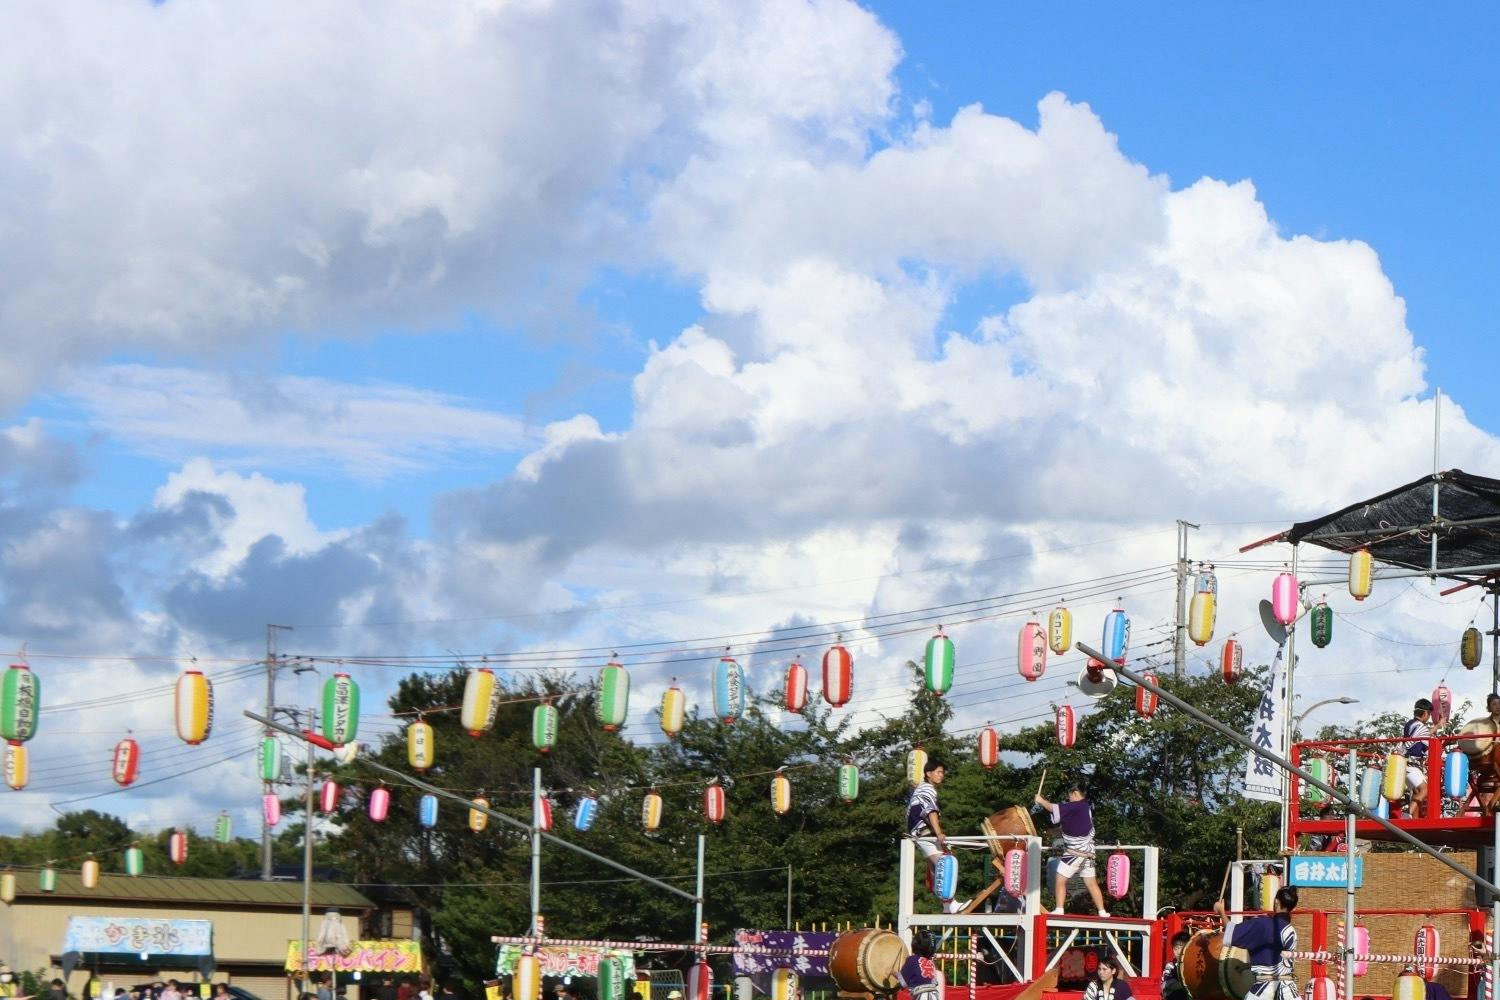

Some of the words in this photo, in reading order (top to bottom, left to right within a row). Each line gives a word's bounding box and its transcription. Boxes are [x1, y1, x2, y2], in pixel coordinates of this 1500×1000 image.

[1032, 628, 1047, 672] 大野園
[104, 922, 181, 950] かき氷
